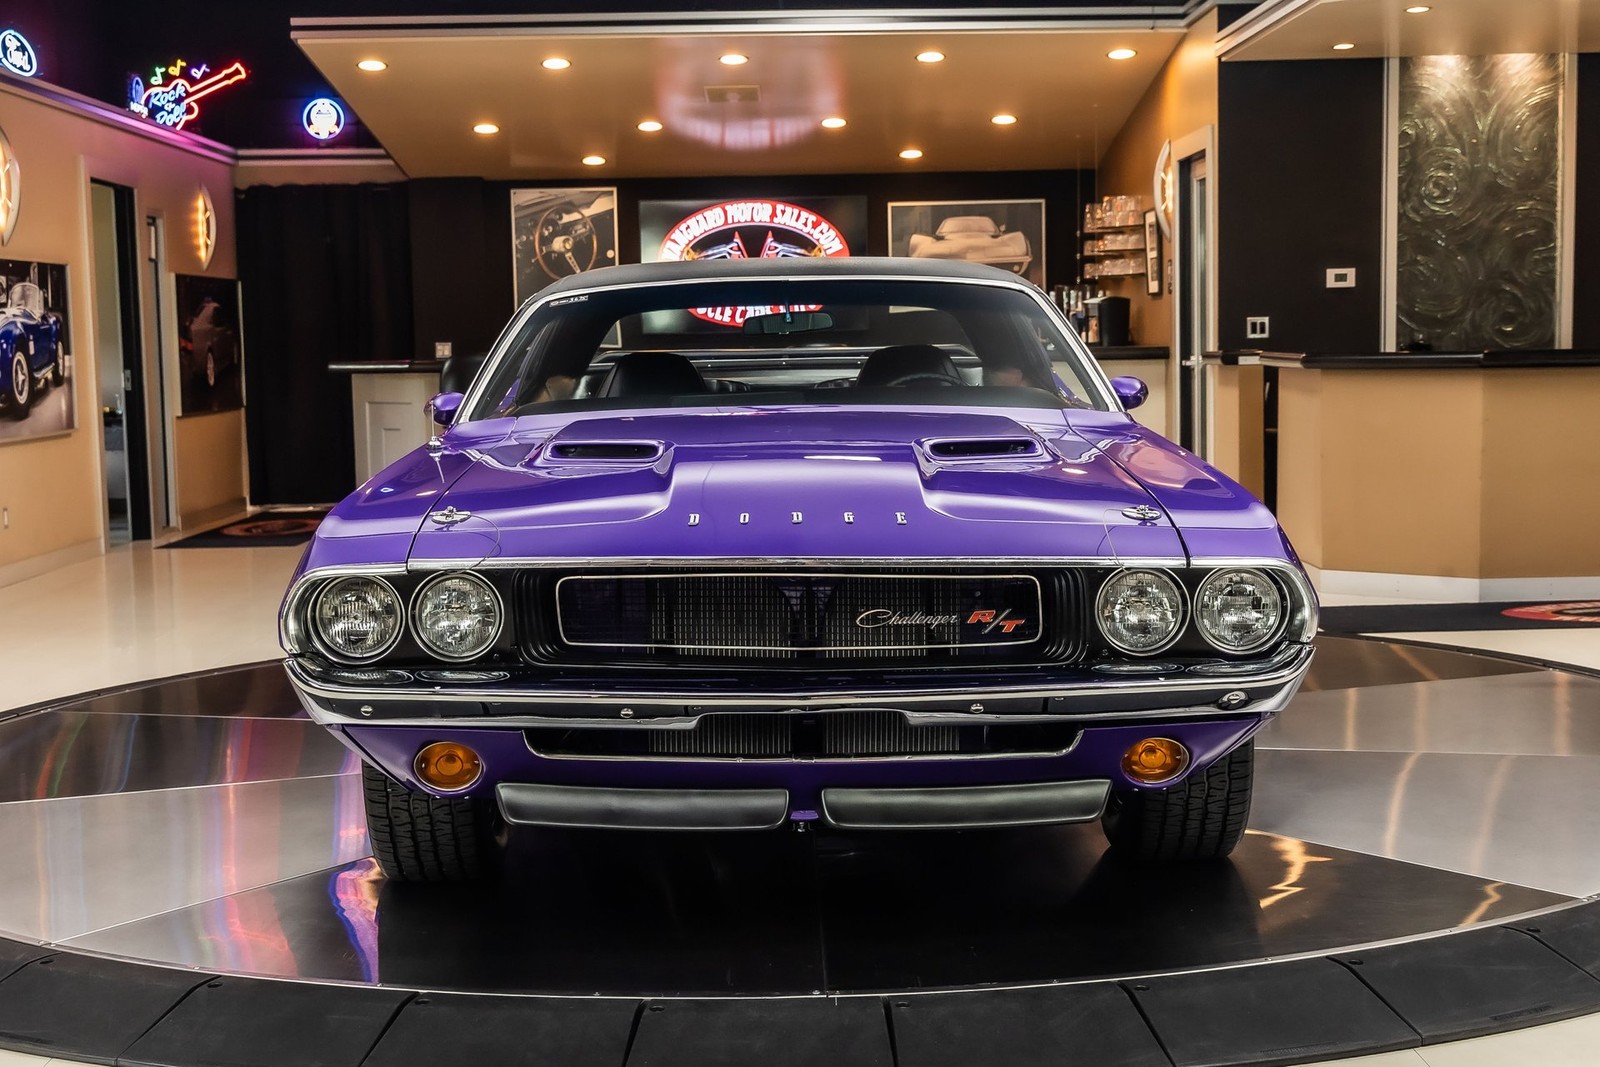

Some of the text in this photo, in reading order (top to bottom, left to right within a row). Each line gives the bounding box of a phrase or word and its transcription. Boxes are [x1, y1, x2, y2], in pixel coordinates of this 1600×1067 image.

[148, 83, 186, 109] Rock
[724, 202, 773, 224] MOTOR
[773, 204, 844, 255] SALES.COM
[687, 511, 908, 526] DODGE
[855, 608, 1026, 635] Challenger R/T
